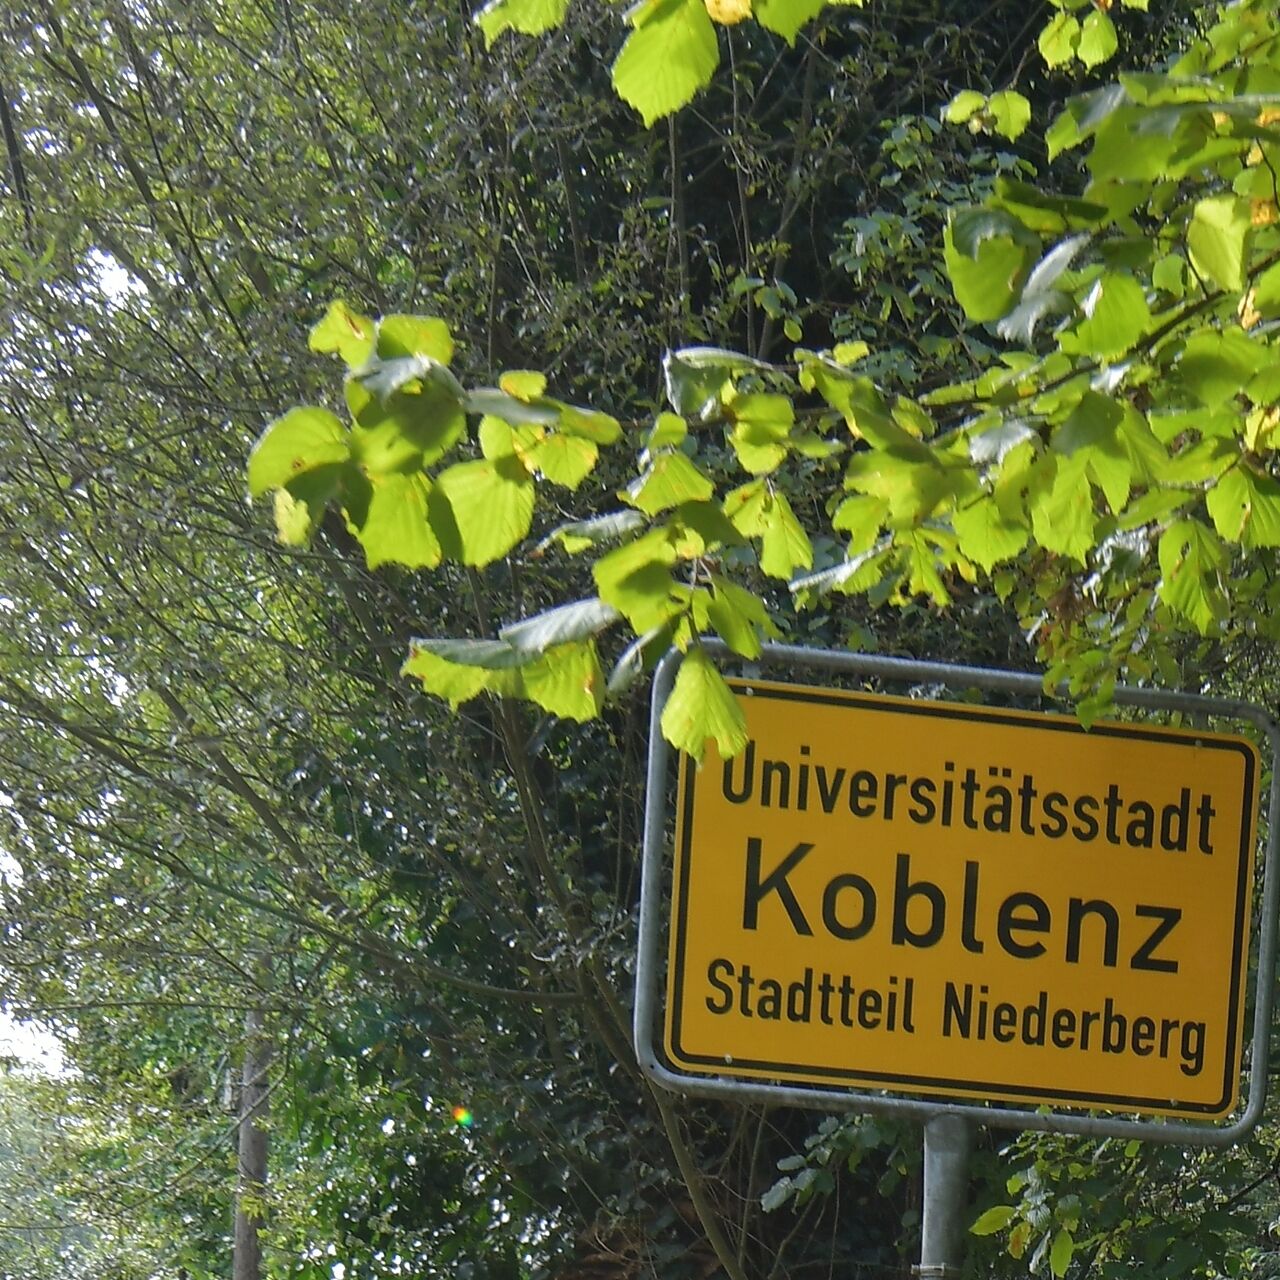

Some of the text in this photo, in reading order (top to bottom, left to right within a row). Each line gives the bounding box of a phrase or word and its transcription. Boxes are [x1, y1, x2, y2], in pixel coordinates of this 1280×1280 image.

[722, 740, 1216, 855] Universitätsstadt
[741, 837, 1183, 974] Koblenz
[705, 957, 1207, 1077] Stadtteil Niederberg
